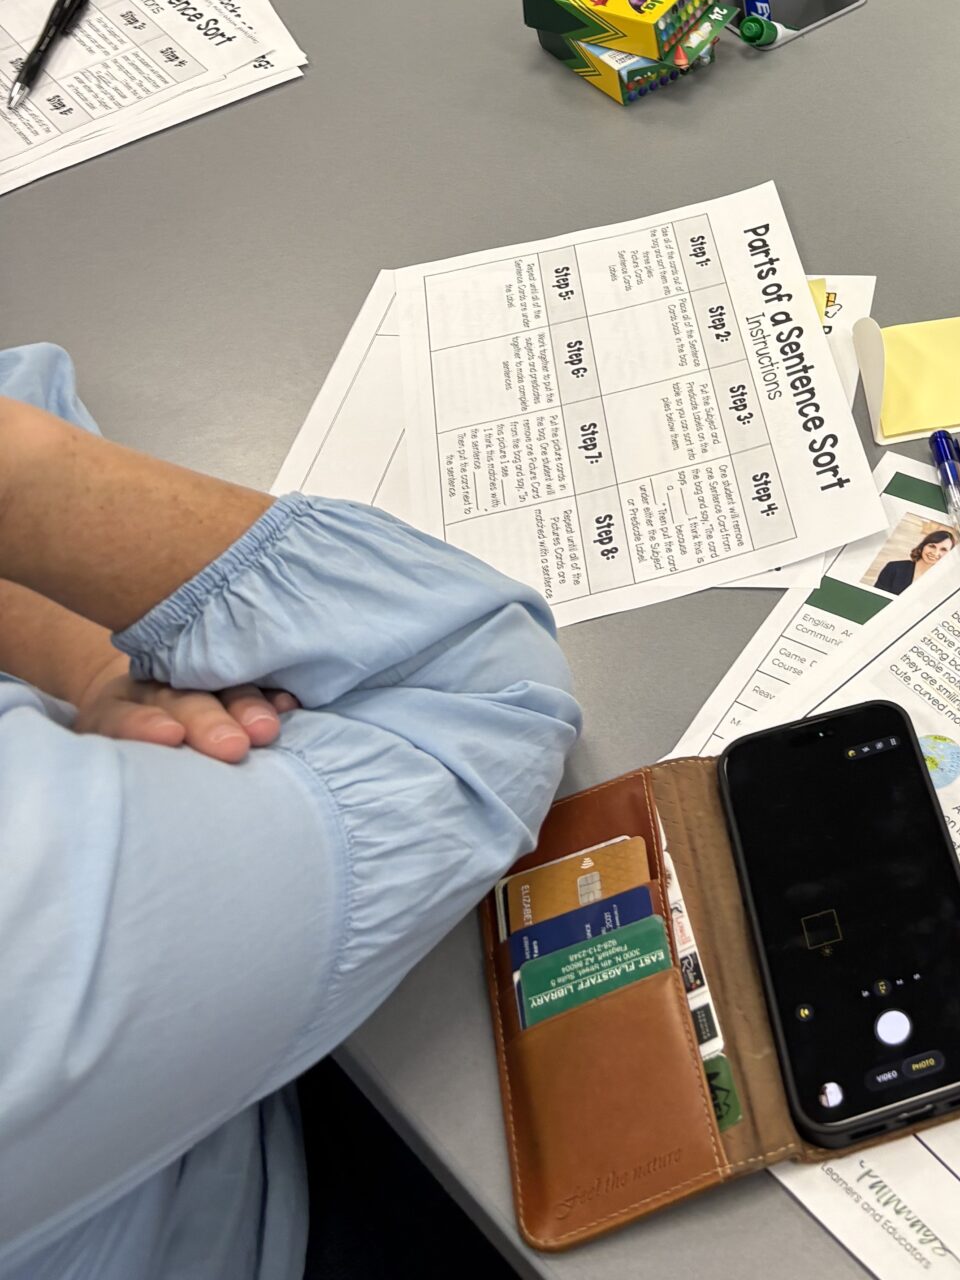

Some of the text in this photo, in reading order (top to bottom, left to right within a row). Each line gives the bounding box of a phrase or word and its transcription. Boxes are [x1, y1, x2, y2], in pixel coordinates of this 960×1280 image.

[120, 11, 139, 26] Step
[197, 18, 236, 46] Sort
[709, 6, 728, 21] 24
[160, 47, 178, 63] Step
[689, 235, 710, 266] Step 1:
[552, 266, 574, 300] Step 5:
[707, 305, 731, 342] Step 2:
[564, 340, 587, 378] Step 6:
[743, 223, 851, 491] Parts of a Sentence Sort
[745, 311, 782, 401] Instructions
[728, 384, 753, 424] Step 3:
[578, 422, 602, 464] Step 7:
[718, 464, 744, 546] One student will remove
[751, 472, 777, 516] Step 4:
[593, 514, 618, 560] Step 8:
[802, 613, 835, 631] English
[772, 658, 803, 676] Course
[779, 648, 806, 665] Game
[531, 951, 664, 1007] EAST FLAGSTAFF LIBRARY
[876, 1058, 935, 1083] VIDEO PHOTO
[820, 1160, 863, 1204] Learners
[861, 1200, 883, 1224] and
[881, 1219, 933, 1270] Educators
